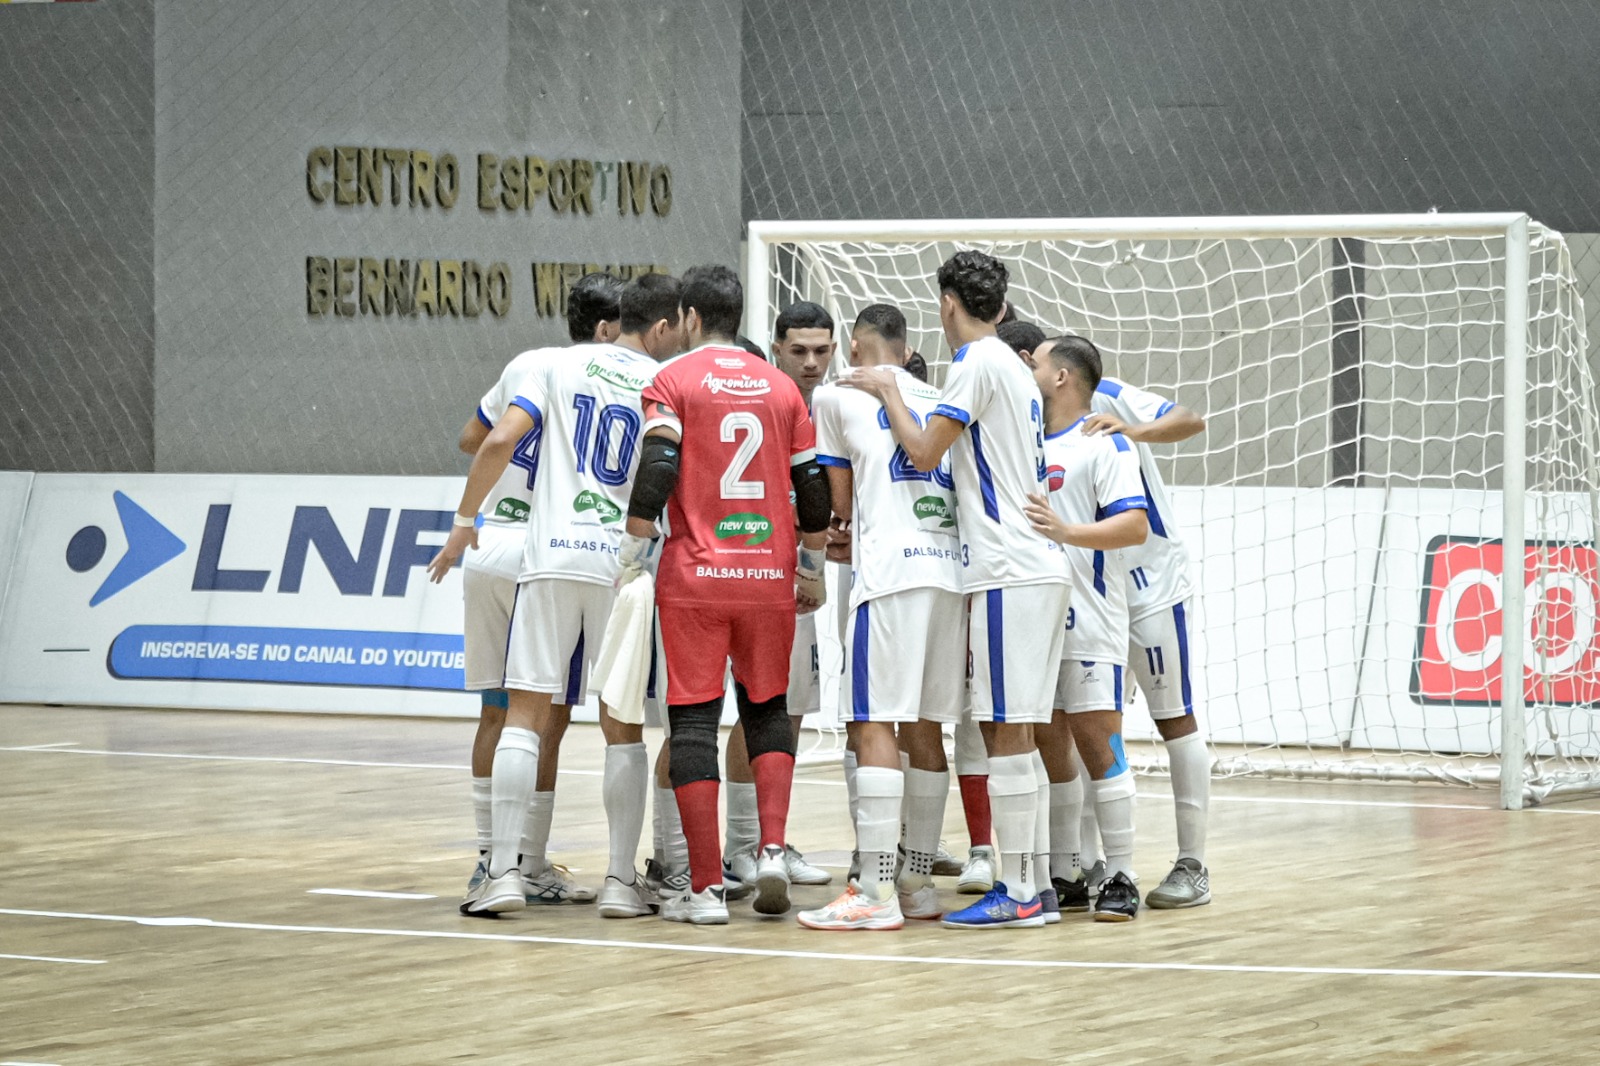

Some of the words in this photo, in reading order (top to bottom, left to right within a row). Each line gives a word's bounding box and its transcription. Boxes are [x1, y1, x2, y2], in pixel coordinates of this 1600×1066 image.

[306, 146, 460, 209] CENTRO
[477, 153, 672, 217] ESPORTIVO
[306, 256, 512, 317] BERNARDO
[701, 372, 770, 395] Agromina
[573, 393, 640, 486] 10
[720, 411, 764, 499] 2
[916, 503, 936, 511] new
[719, 521, 743, 531] new
[745, 521, 768, 534] agro
[191, 503, 464, 597] LNF
[550, 538, 597, 552] BALSAS
[904, 546, 943, 559] BALSAS
[696, 566, 744, 579] BALSAS
[747, 567, 784, 580] FUTSAL
[1129, 566, 1149, 590] 11
[140, 641, 259, 660] INSCREVA-SE
[262, 644, 290, 662] NO
[294, 645, 356, 665] CANAL
[360, 647, 388, 666] DO
[392, 649, 465, 669] YOUTUB
[1145, 646, 1165, 676] 11
